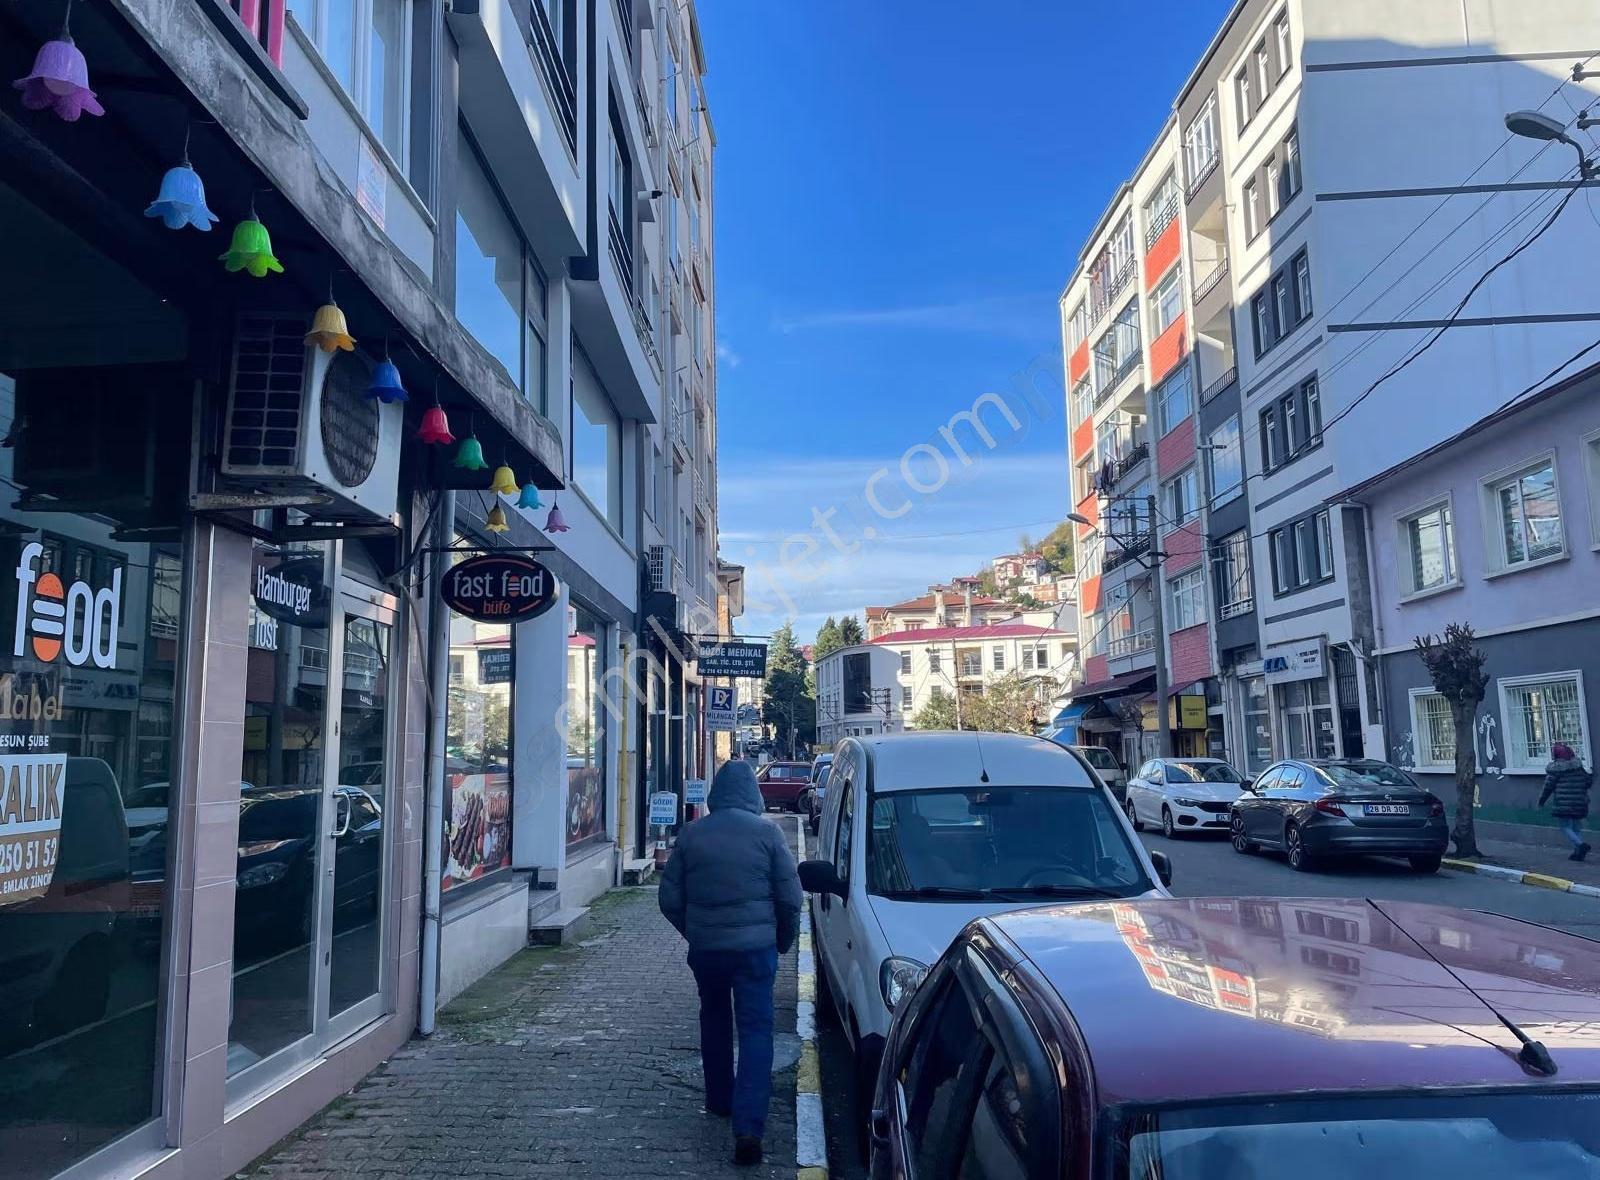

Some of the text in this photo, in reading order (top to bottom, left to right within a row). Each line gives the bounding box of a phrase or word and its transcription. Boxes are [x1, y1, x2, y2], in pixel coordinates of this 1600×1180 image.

[257, 565, 312, 615] Hamburger
[453, 570, 494, 598] fast
[483, 600, 511, 614] büfe
[255, 611, 279, 650] Tost
[700, 645, 763, 658] GÖZDE MEDİKAL
[28, 735, 49, 751] ŞUBE
[1370, 805, 1380, 813] 28
[1381, 805, 1392, 813] DR
[0, 837, 57, 874] 250 51 52
[4, 877, 29, 894] EMLAK
